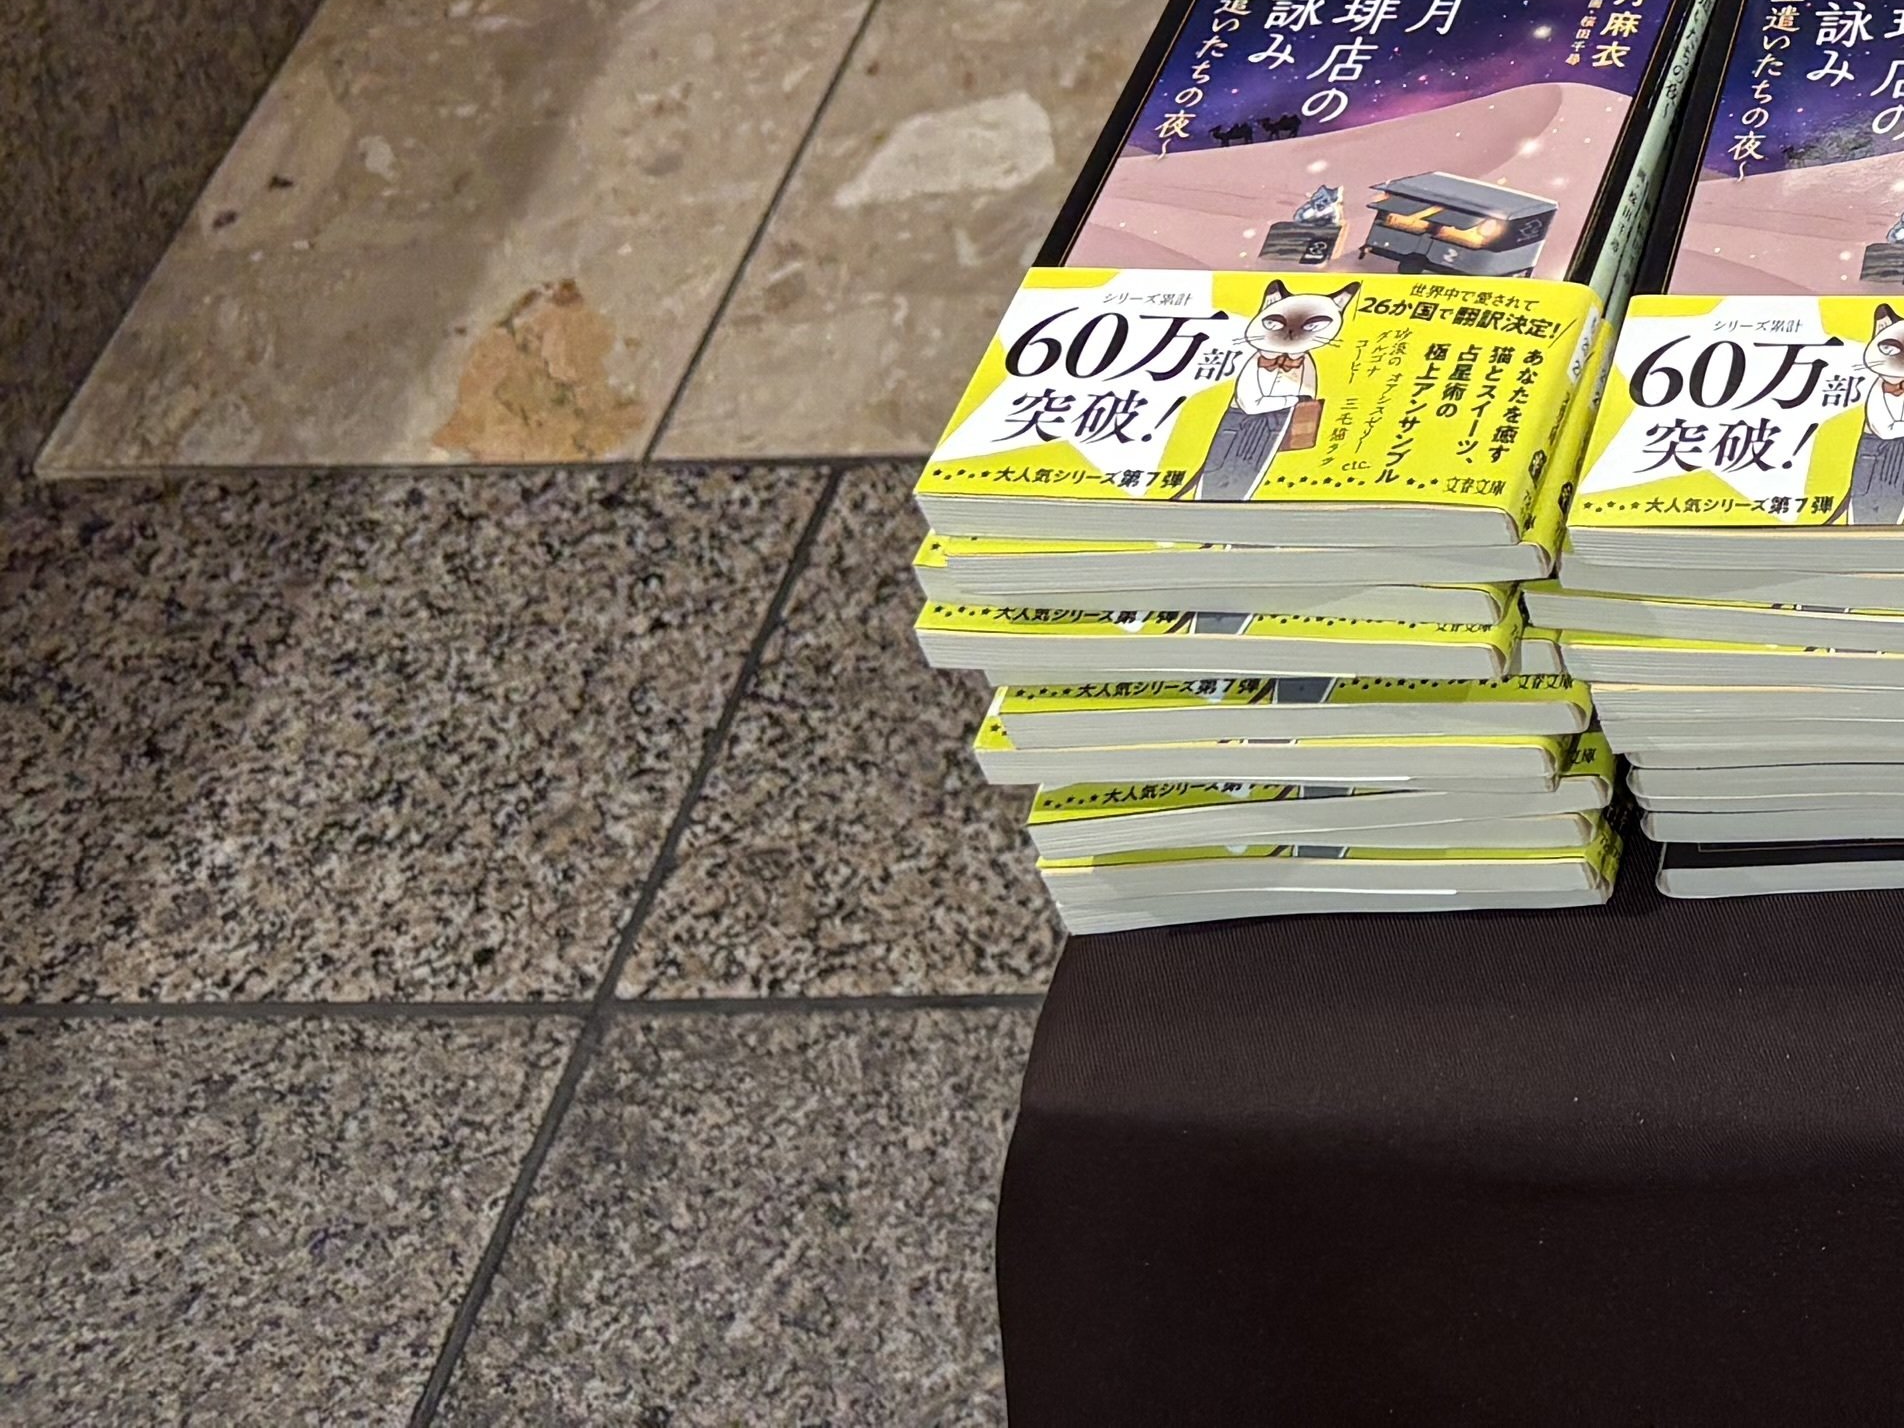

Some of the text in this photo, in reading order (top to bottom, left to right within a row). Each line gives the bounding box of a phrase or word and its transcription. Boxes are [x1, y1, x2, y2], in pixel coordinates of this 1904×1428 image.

[1004, 306, 1243, 383] 60万部
[1435, 344, 1482, 418] 占星術の
[1002, 388, 1191, 445] 突破!
[993, 467, 1186, 490] 大人気シリーズ第7弾
[1644, 496, 1835, 515] 大人気シリーズ第7弾
